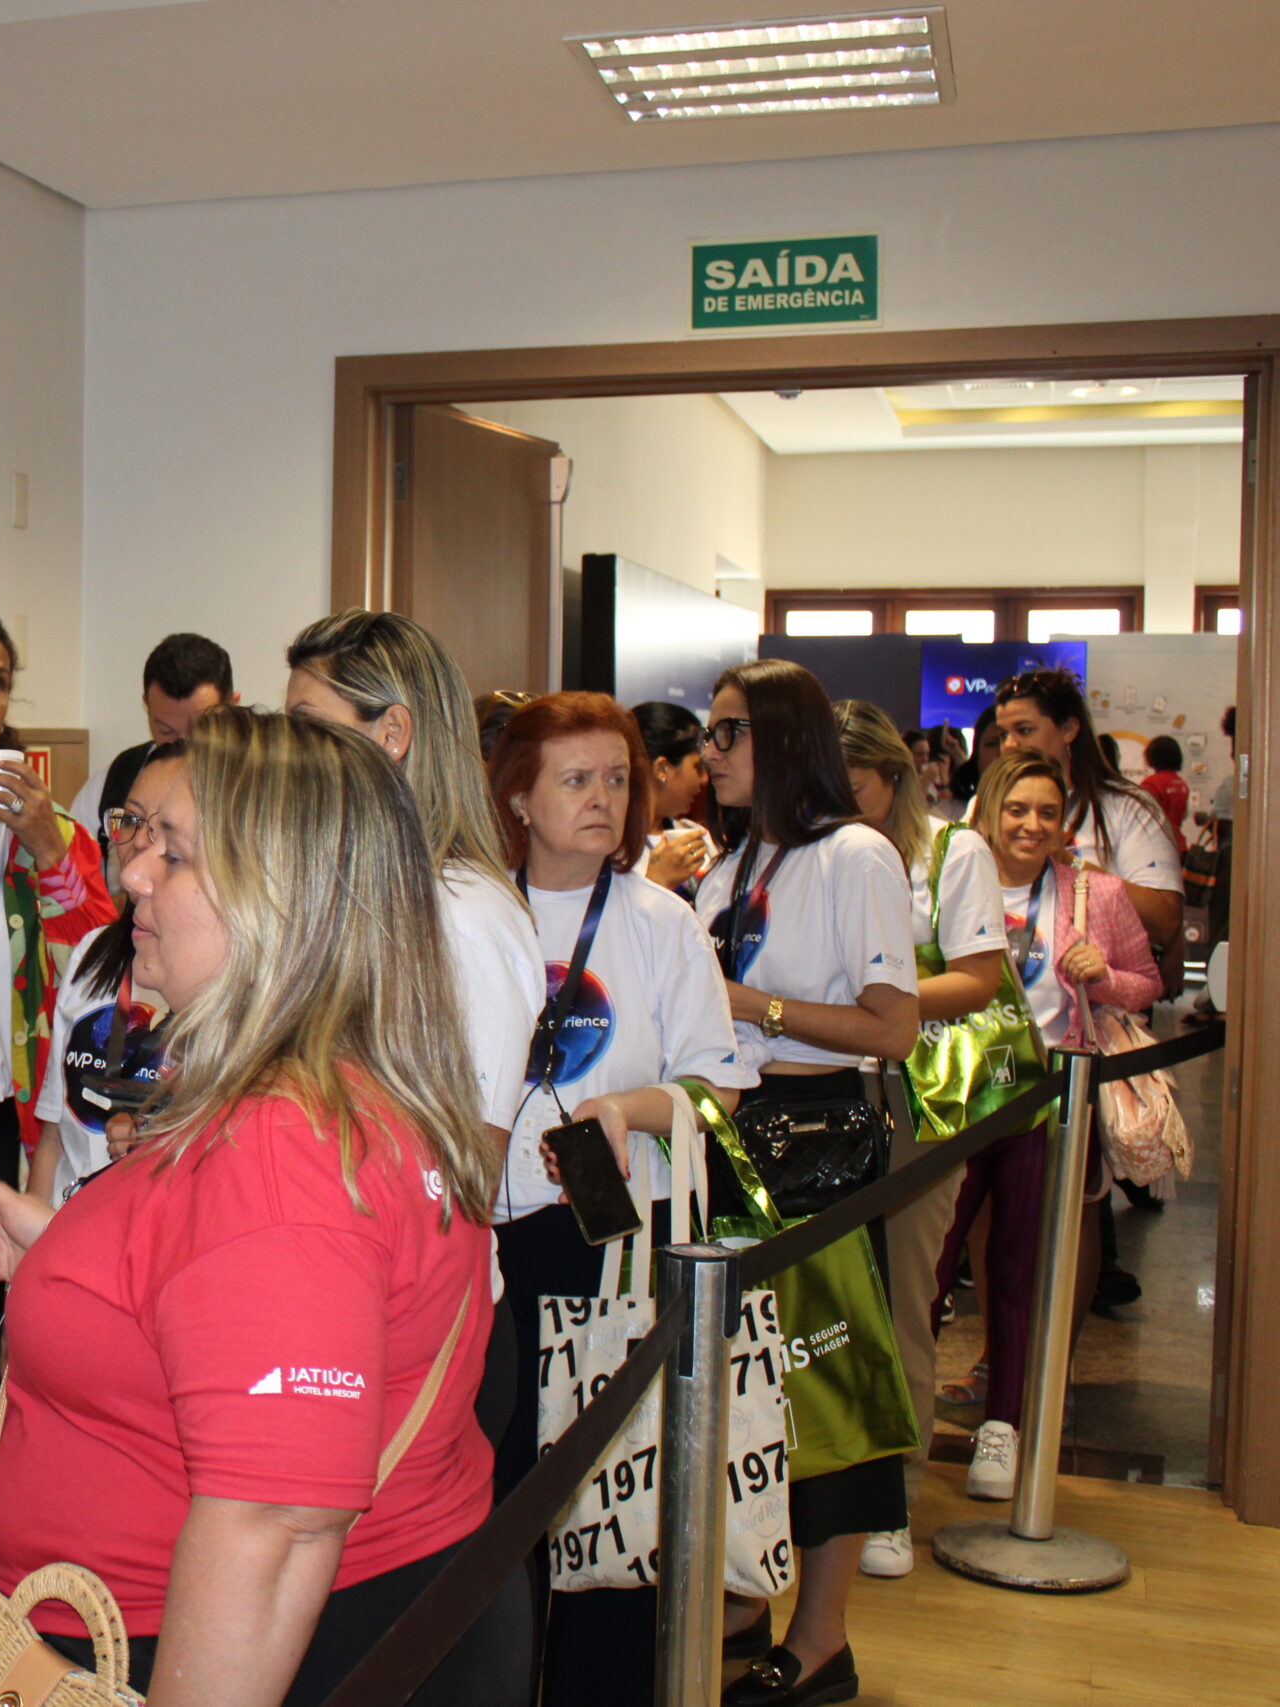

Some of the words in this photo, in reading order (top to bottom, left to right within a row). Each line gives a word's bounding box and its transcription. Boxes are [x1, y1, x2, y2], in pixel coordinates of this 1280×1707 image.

[704, 249, 865, 291] SAÍDA
[704, 296, 729, 313] DE
[735, 289, 864, 312] EMERGÊNCIA
[809, 1321, 848, 1346] SEGURO
[813, 1334, 850, 1357] VIAGEM
[287, 1367, 366, 1389] JATIÚCA
[293, 1386, 322, 1397] HOTEL
[324, 1387, 332, 1398] &
[333, 1388, 362, 1400] RESORT
[551, 1514, 626, 1576] 1971
